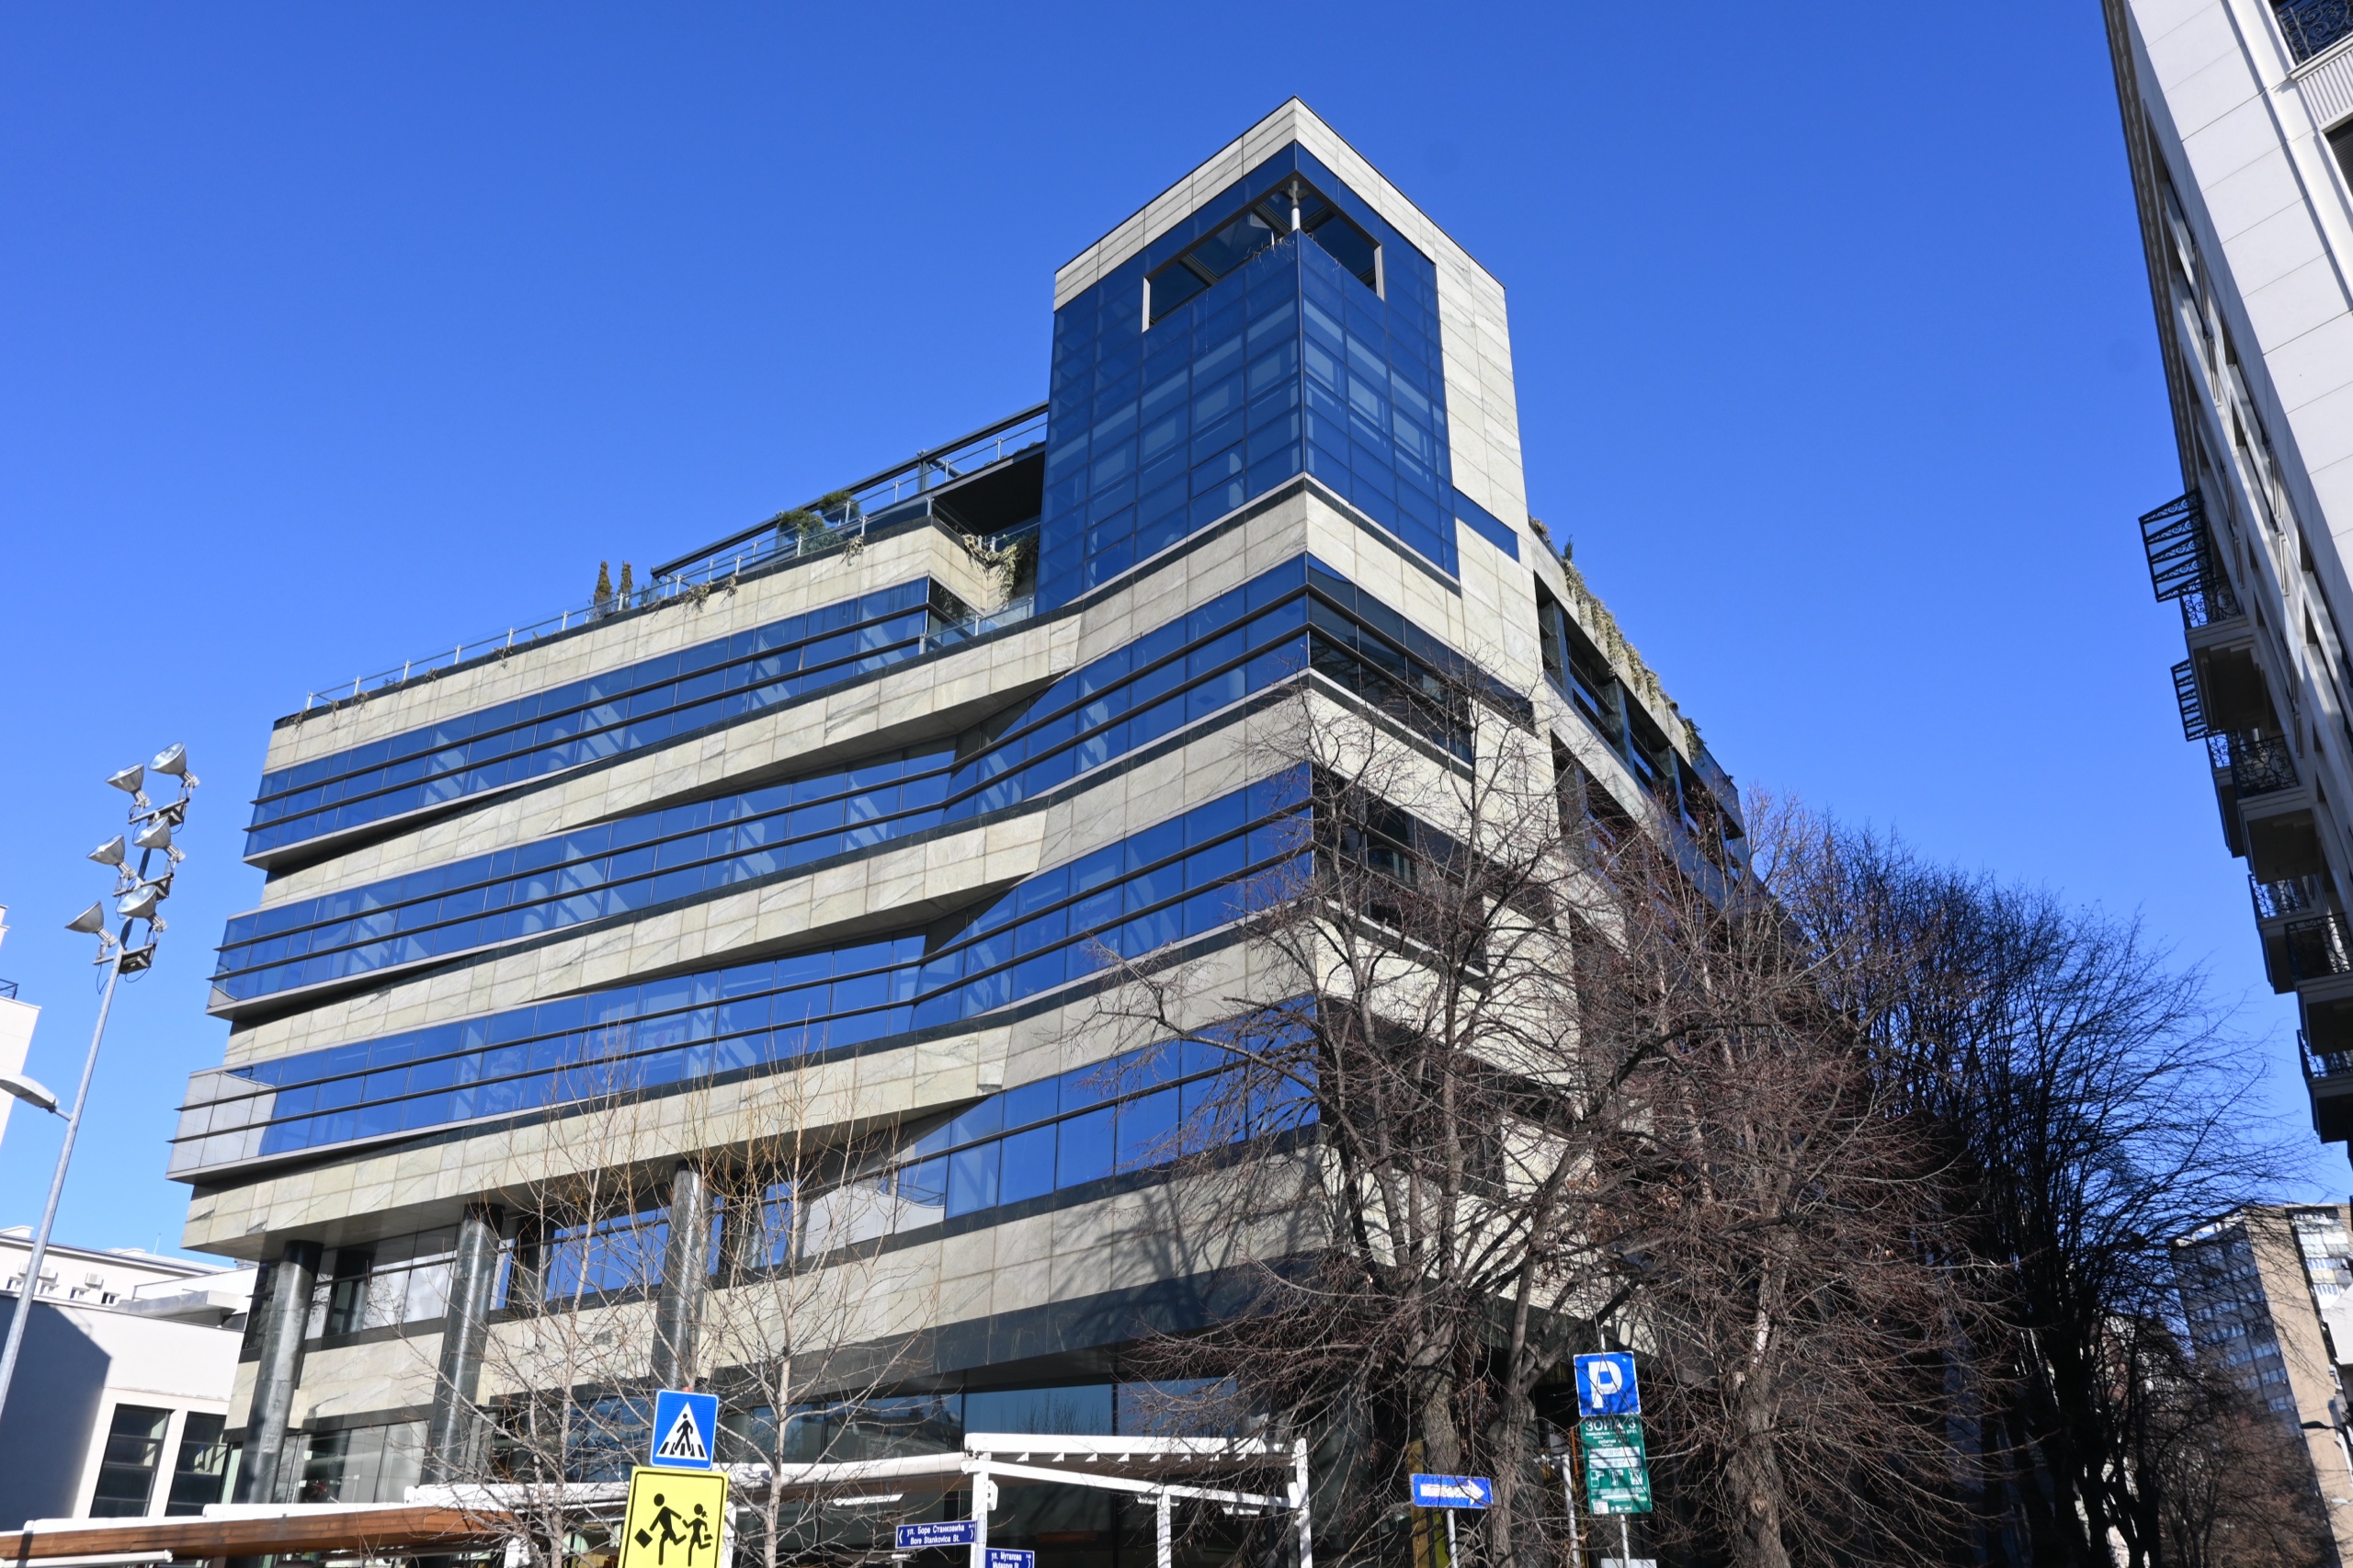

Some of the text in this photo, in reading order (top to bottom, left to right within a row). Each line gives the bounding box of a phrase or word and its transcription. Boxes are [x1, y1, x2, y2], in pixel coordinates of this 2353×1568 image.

[1588, 1360, 1622, 1408] P
[1586, 1417, 1636, 1431] ЗОНА 3
[917, 1526, 930, 1535] Боре
[933, 1523, 965, 1533] Станковића
[910, 1537, 922, 1545] Bore
[952, 1534, 961, 1542] St.
